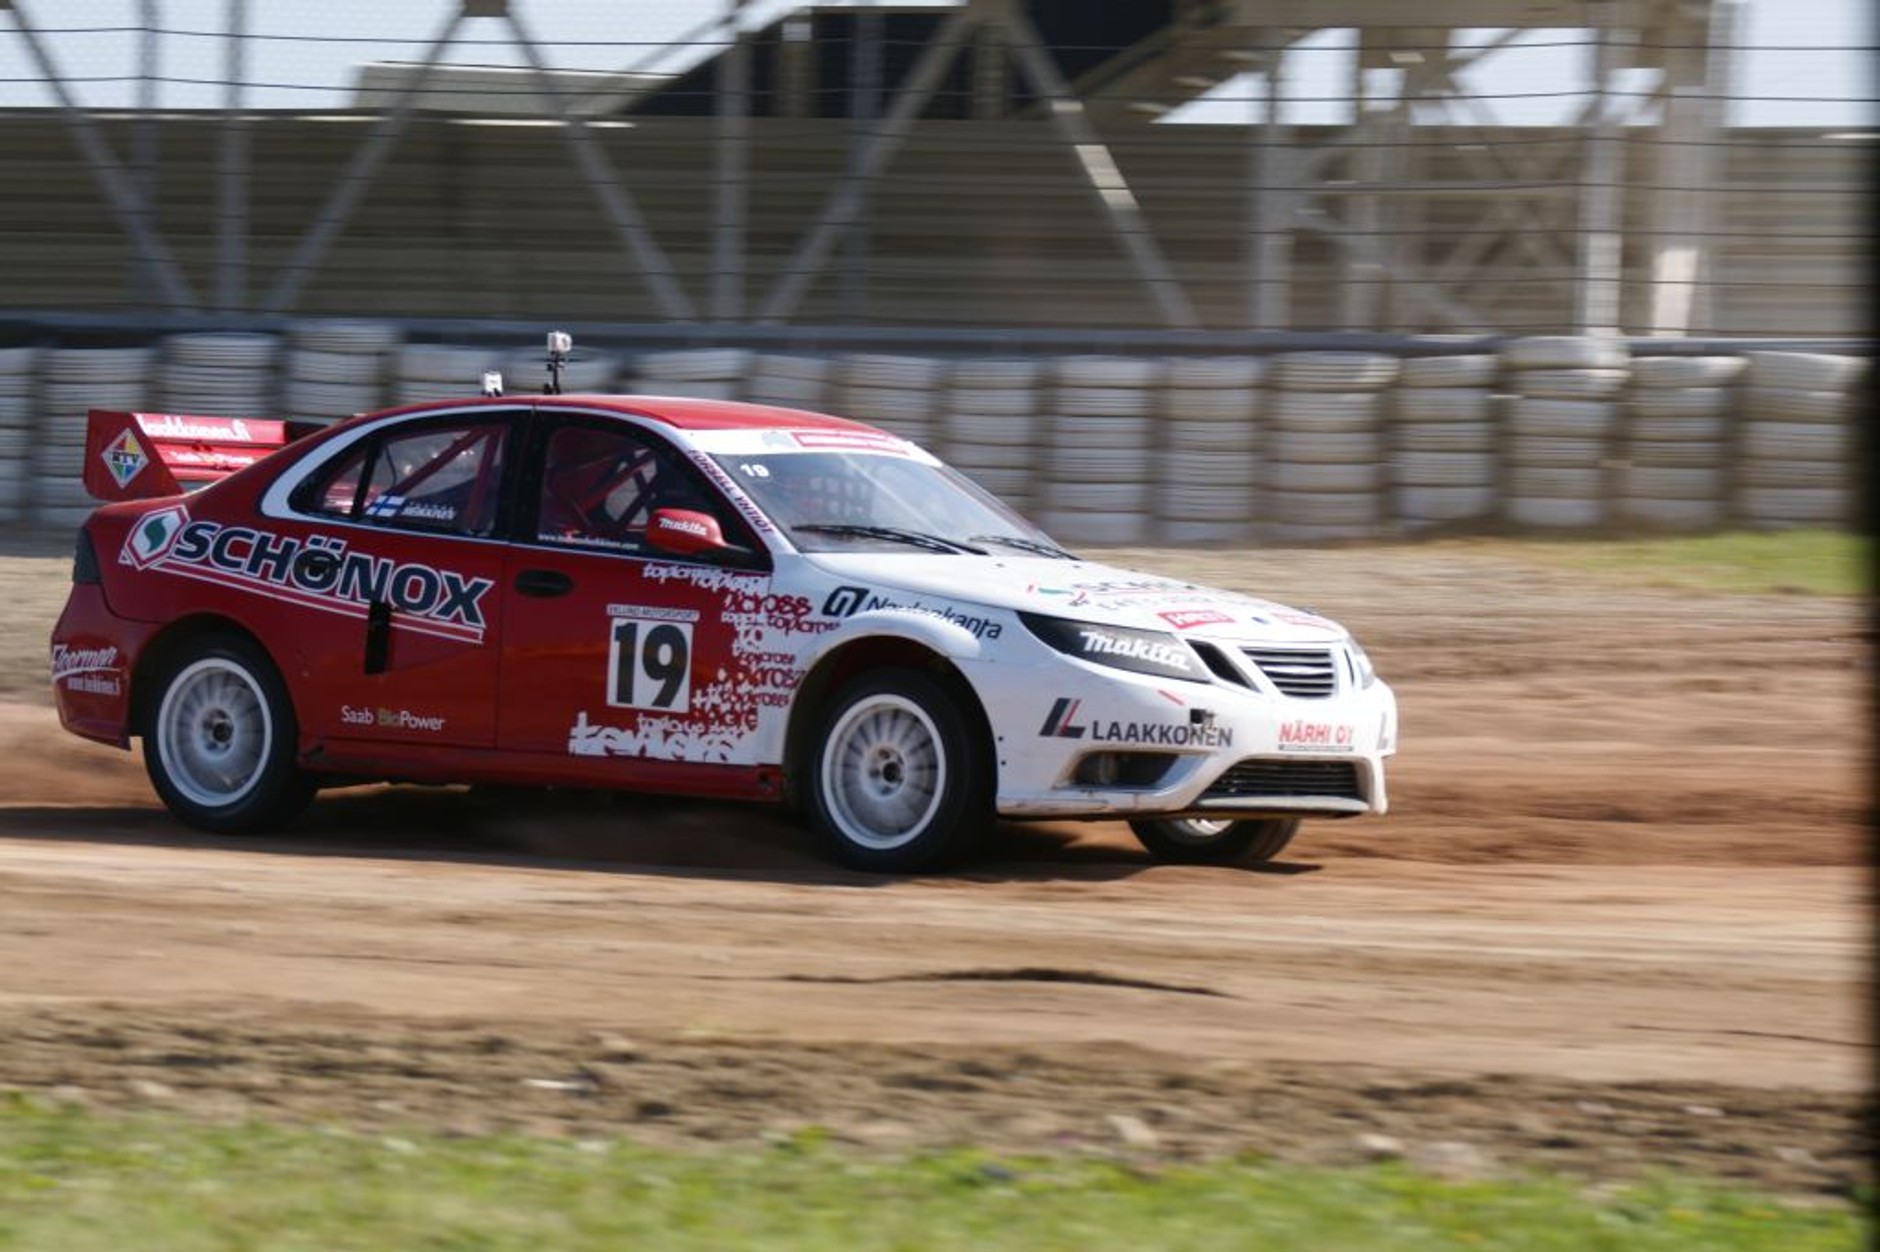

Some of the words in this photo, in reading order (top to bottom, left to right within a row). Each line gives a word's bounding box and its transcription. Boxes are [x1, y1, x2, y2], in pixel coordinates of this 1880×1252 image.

[740, 463, 769, 477] 19
[174, 521, 493, 628] SCHÖNOX
[866, 595, 1002, 640] Nkanta
[614, 621, 688, 708] 19
[1079, 631, 1191, 672] Makita
[341, 704, 375, 725] Saab
[377, 707, 446, 731] BioPower
[1091, 720, 1233, 747] LAAKKONEN
